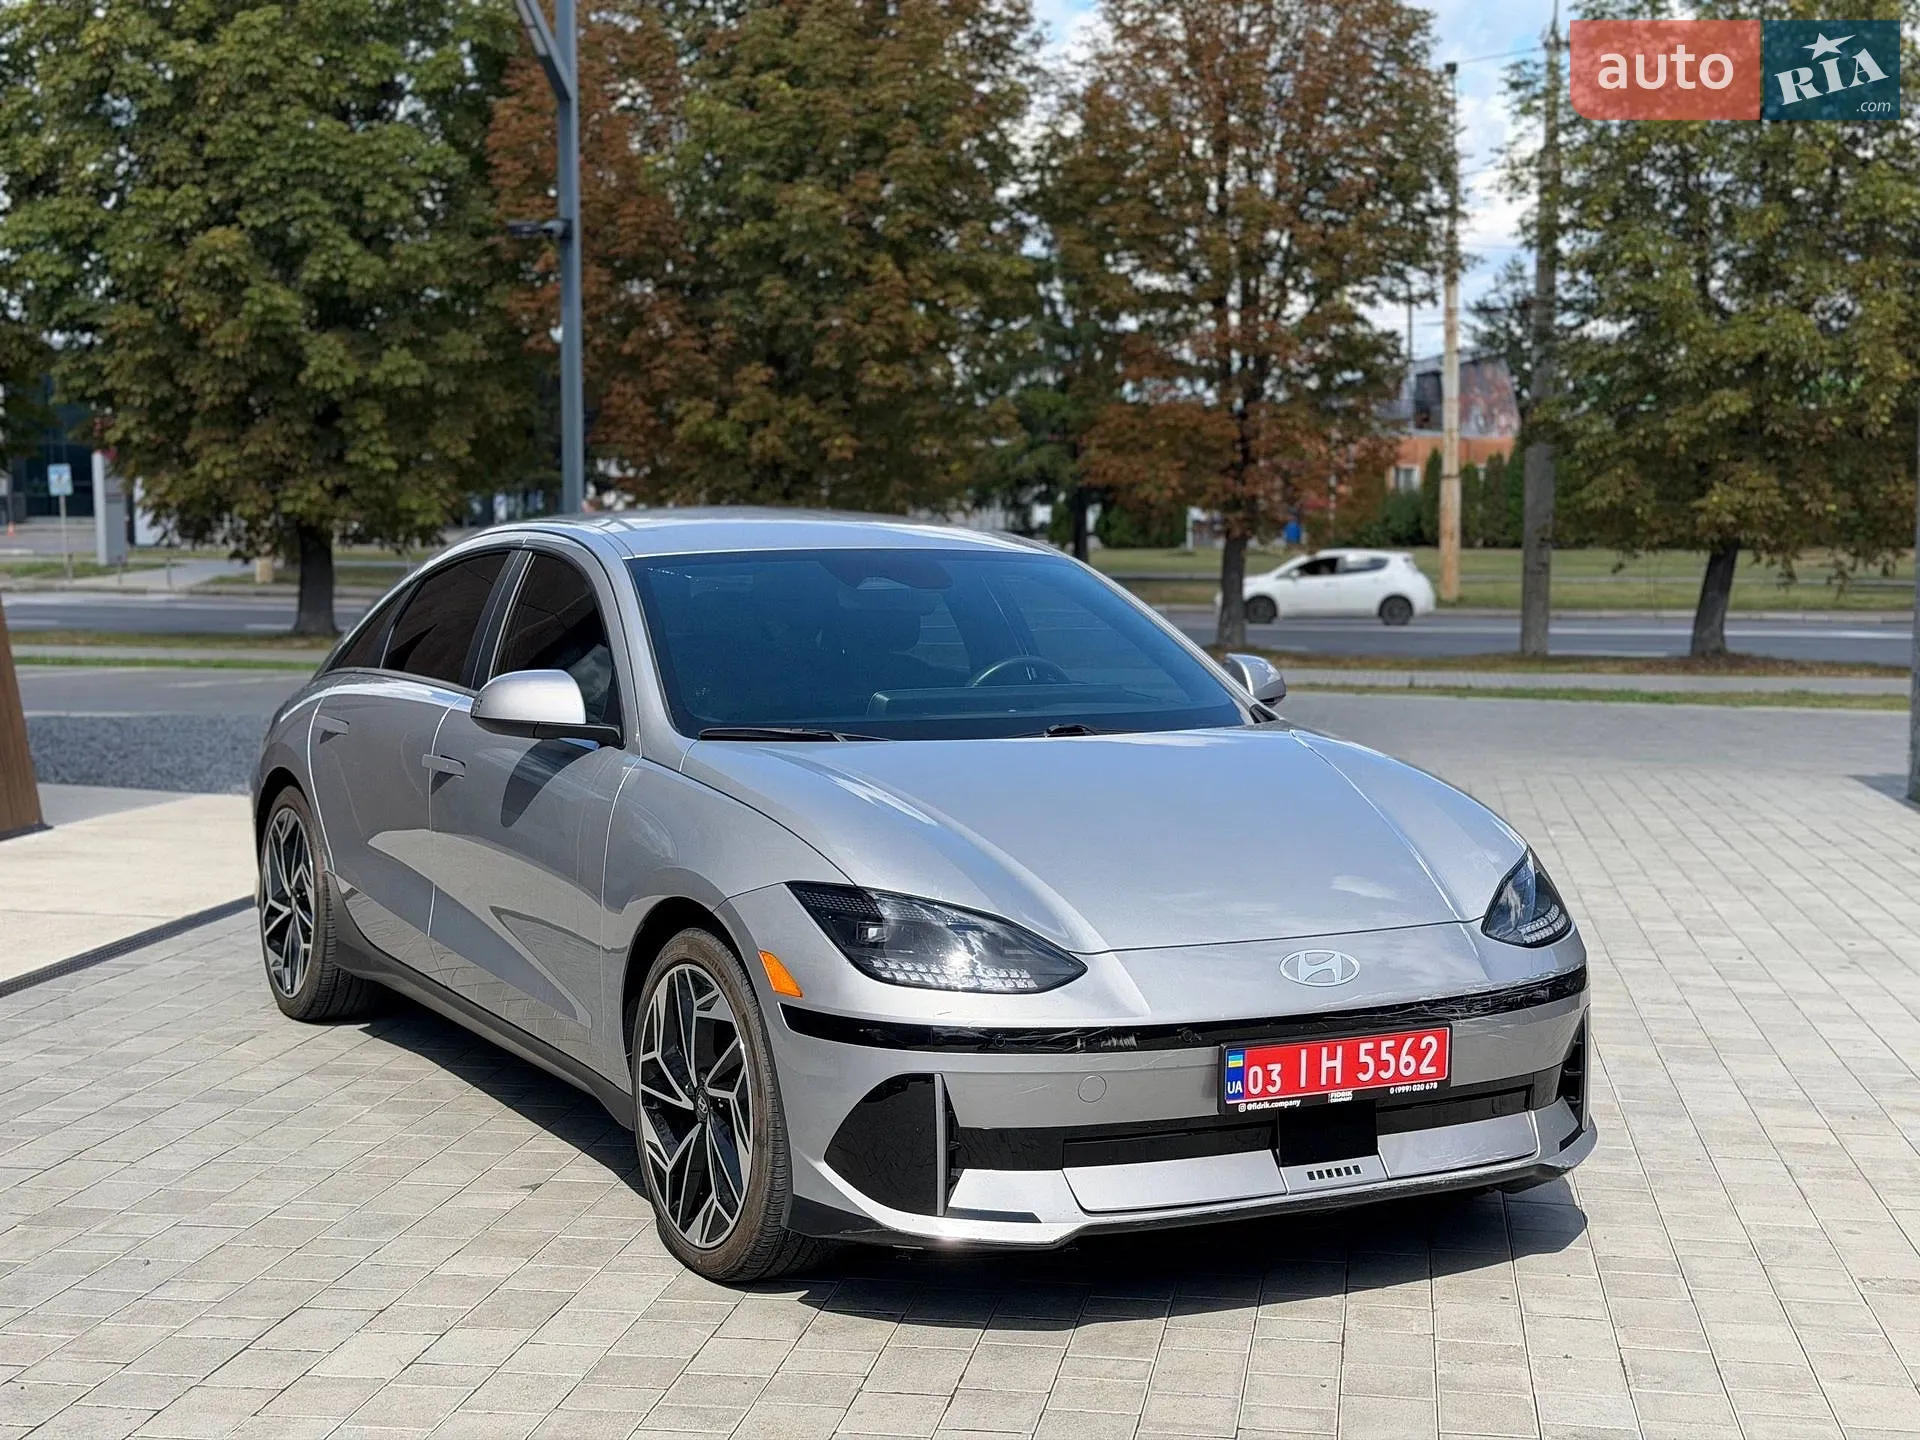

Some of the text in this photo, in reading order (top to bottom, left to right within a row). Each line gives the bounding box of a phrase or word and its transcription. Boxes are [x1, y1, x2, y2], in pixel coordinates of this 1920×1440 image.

[1247, 1063, 1283, 1095] 03
[1356, 1035, 1439, 1082] 5562
[1227, 1081, 1243, 1095] UA
